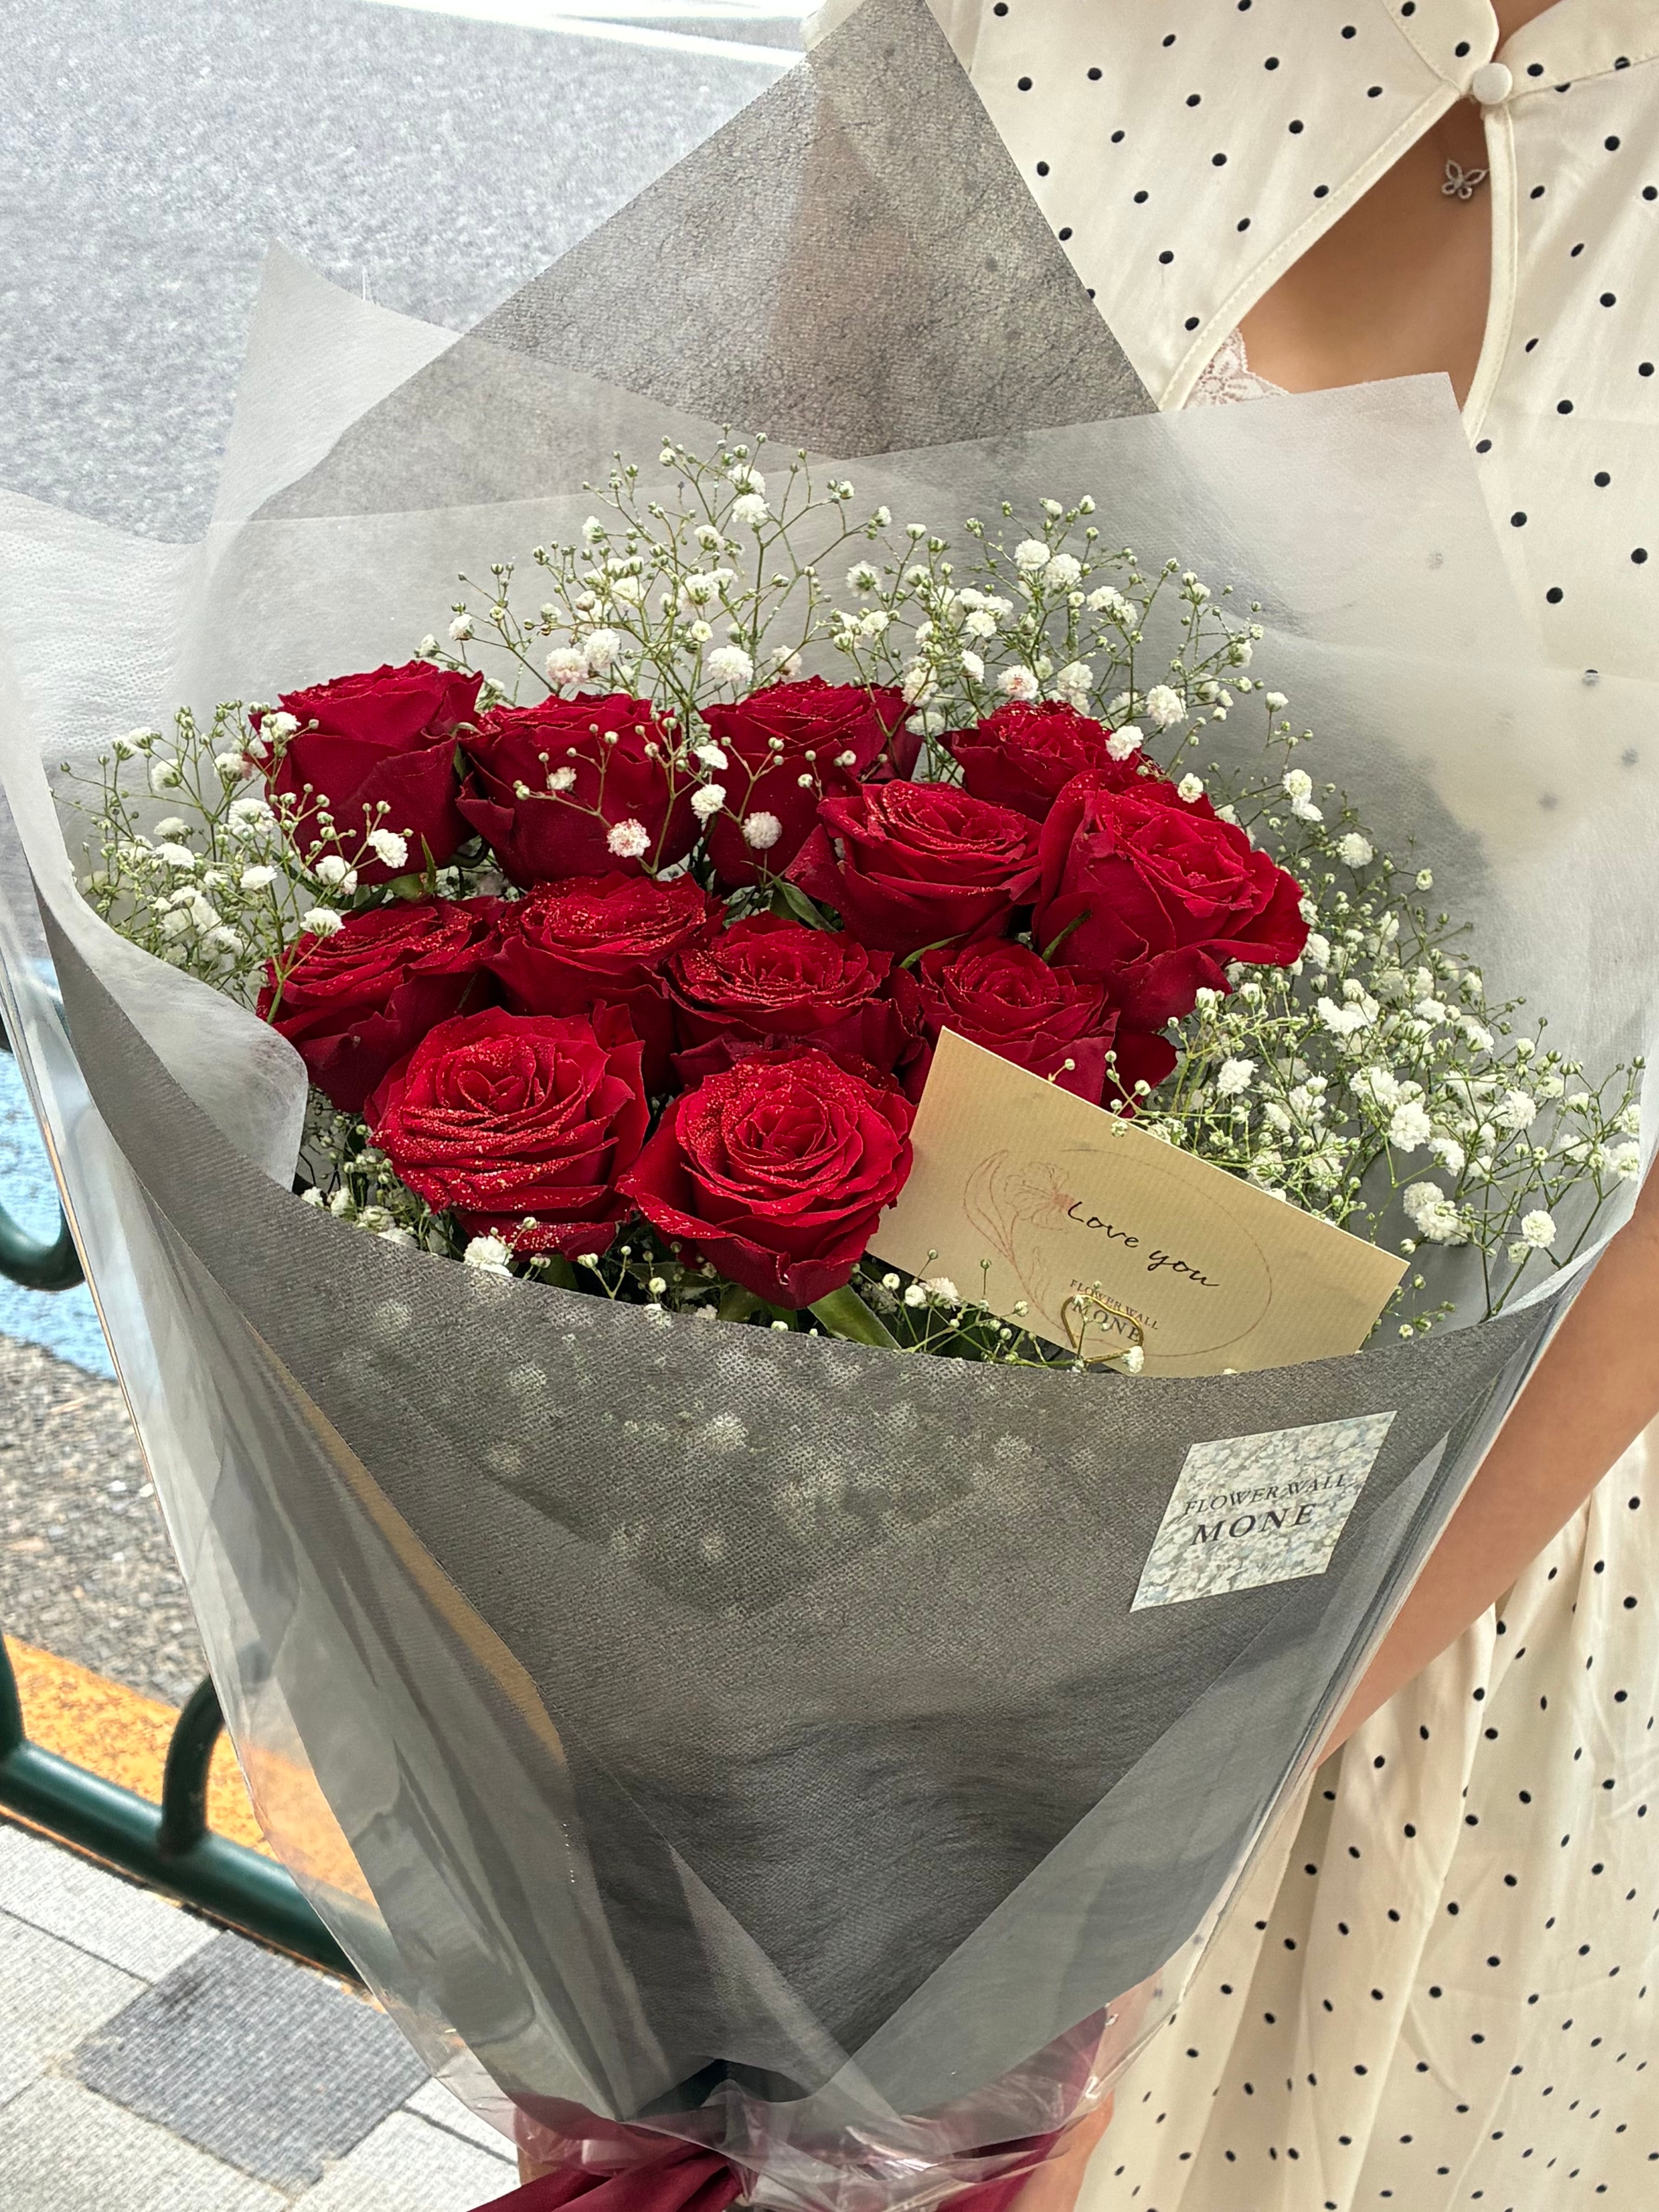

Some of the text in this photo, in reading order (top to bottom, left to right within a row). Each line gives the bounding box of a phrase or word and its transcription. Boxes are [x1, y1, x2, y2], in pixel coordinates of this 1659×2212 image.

[1067, 1201, 1220, 1286] Love you
[1125, 1306, 1159, 1330] WALL
[1184, 1473, 1346, 1515] FLOWER WALL
[1190, 1503, 1317, 1546] MONE
